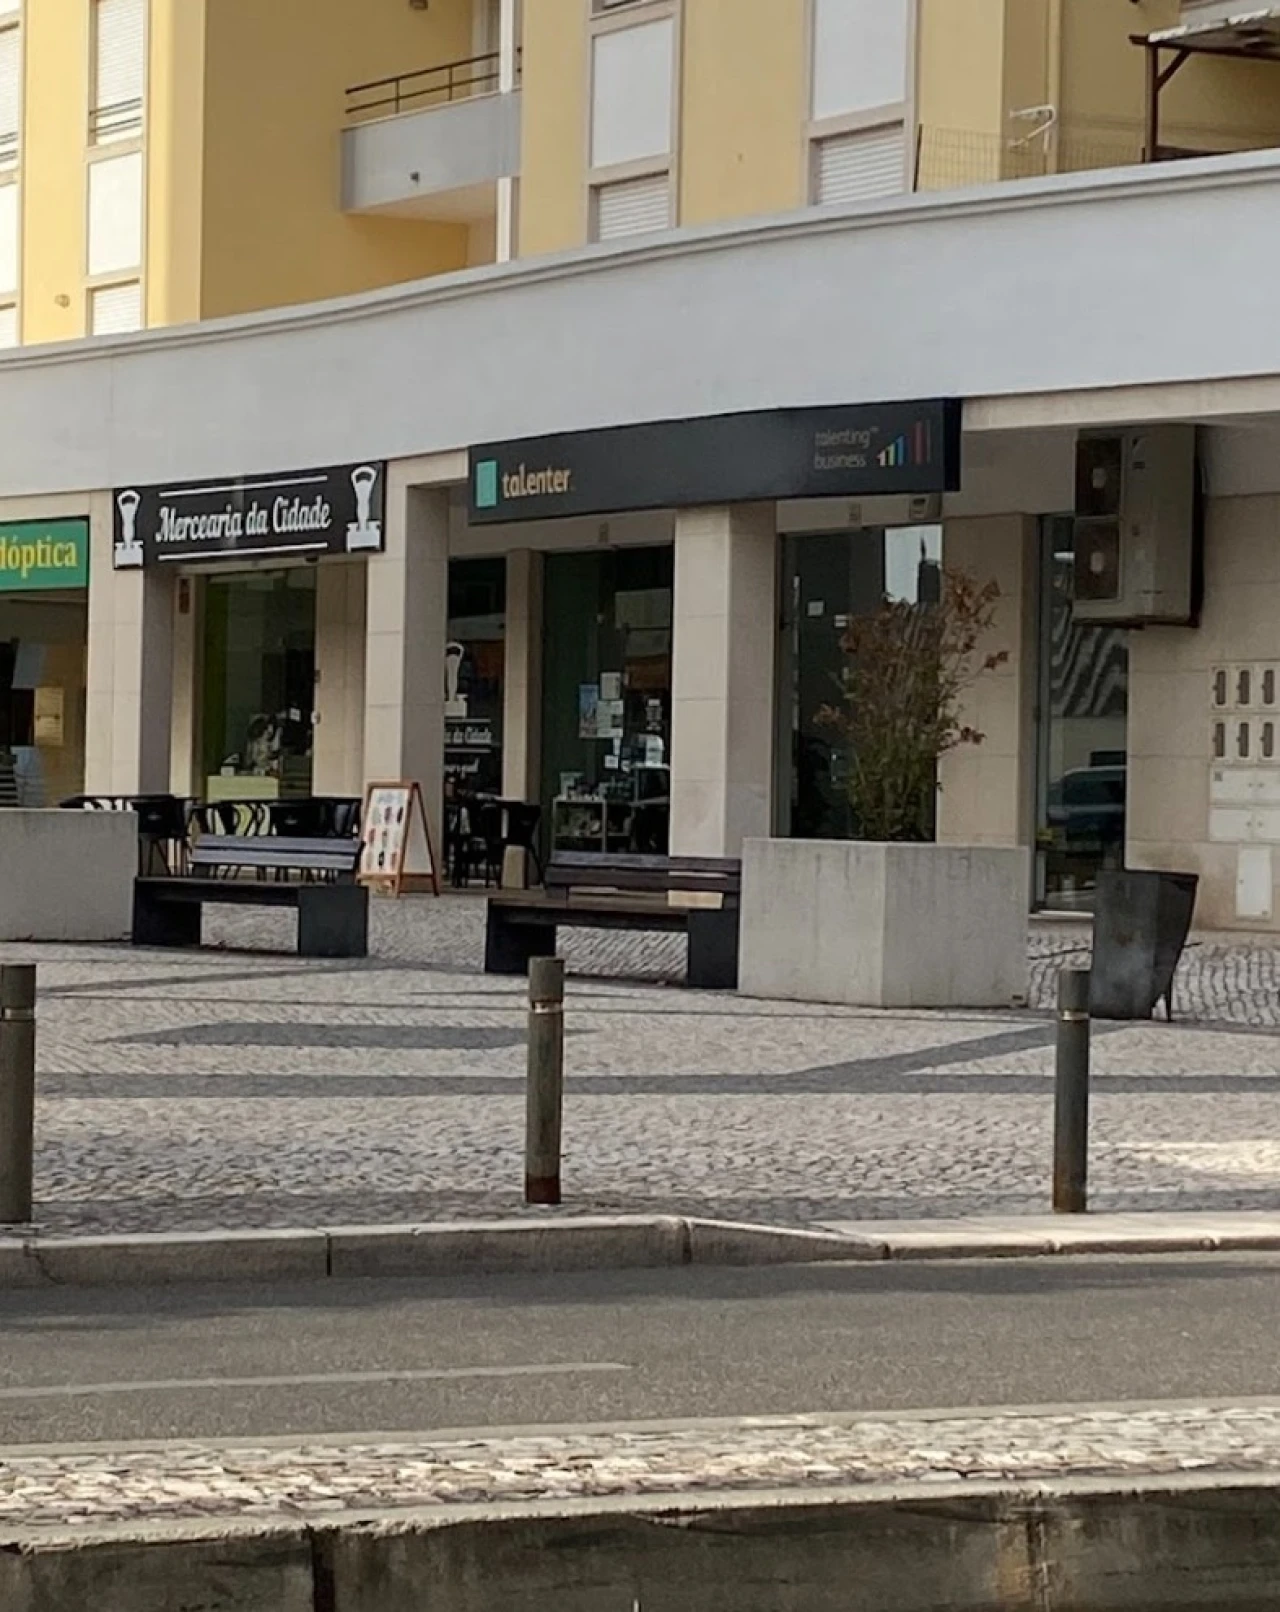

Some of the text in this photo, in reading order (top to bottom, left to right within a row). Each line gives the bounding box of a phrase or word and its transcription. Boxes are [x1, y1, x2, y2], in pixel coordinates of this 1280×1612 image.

[502, 463, 571, 499] talenter
[155, 495, 332, 542] Mercearia da Cidade
